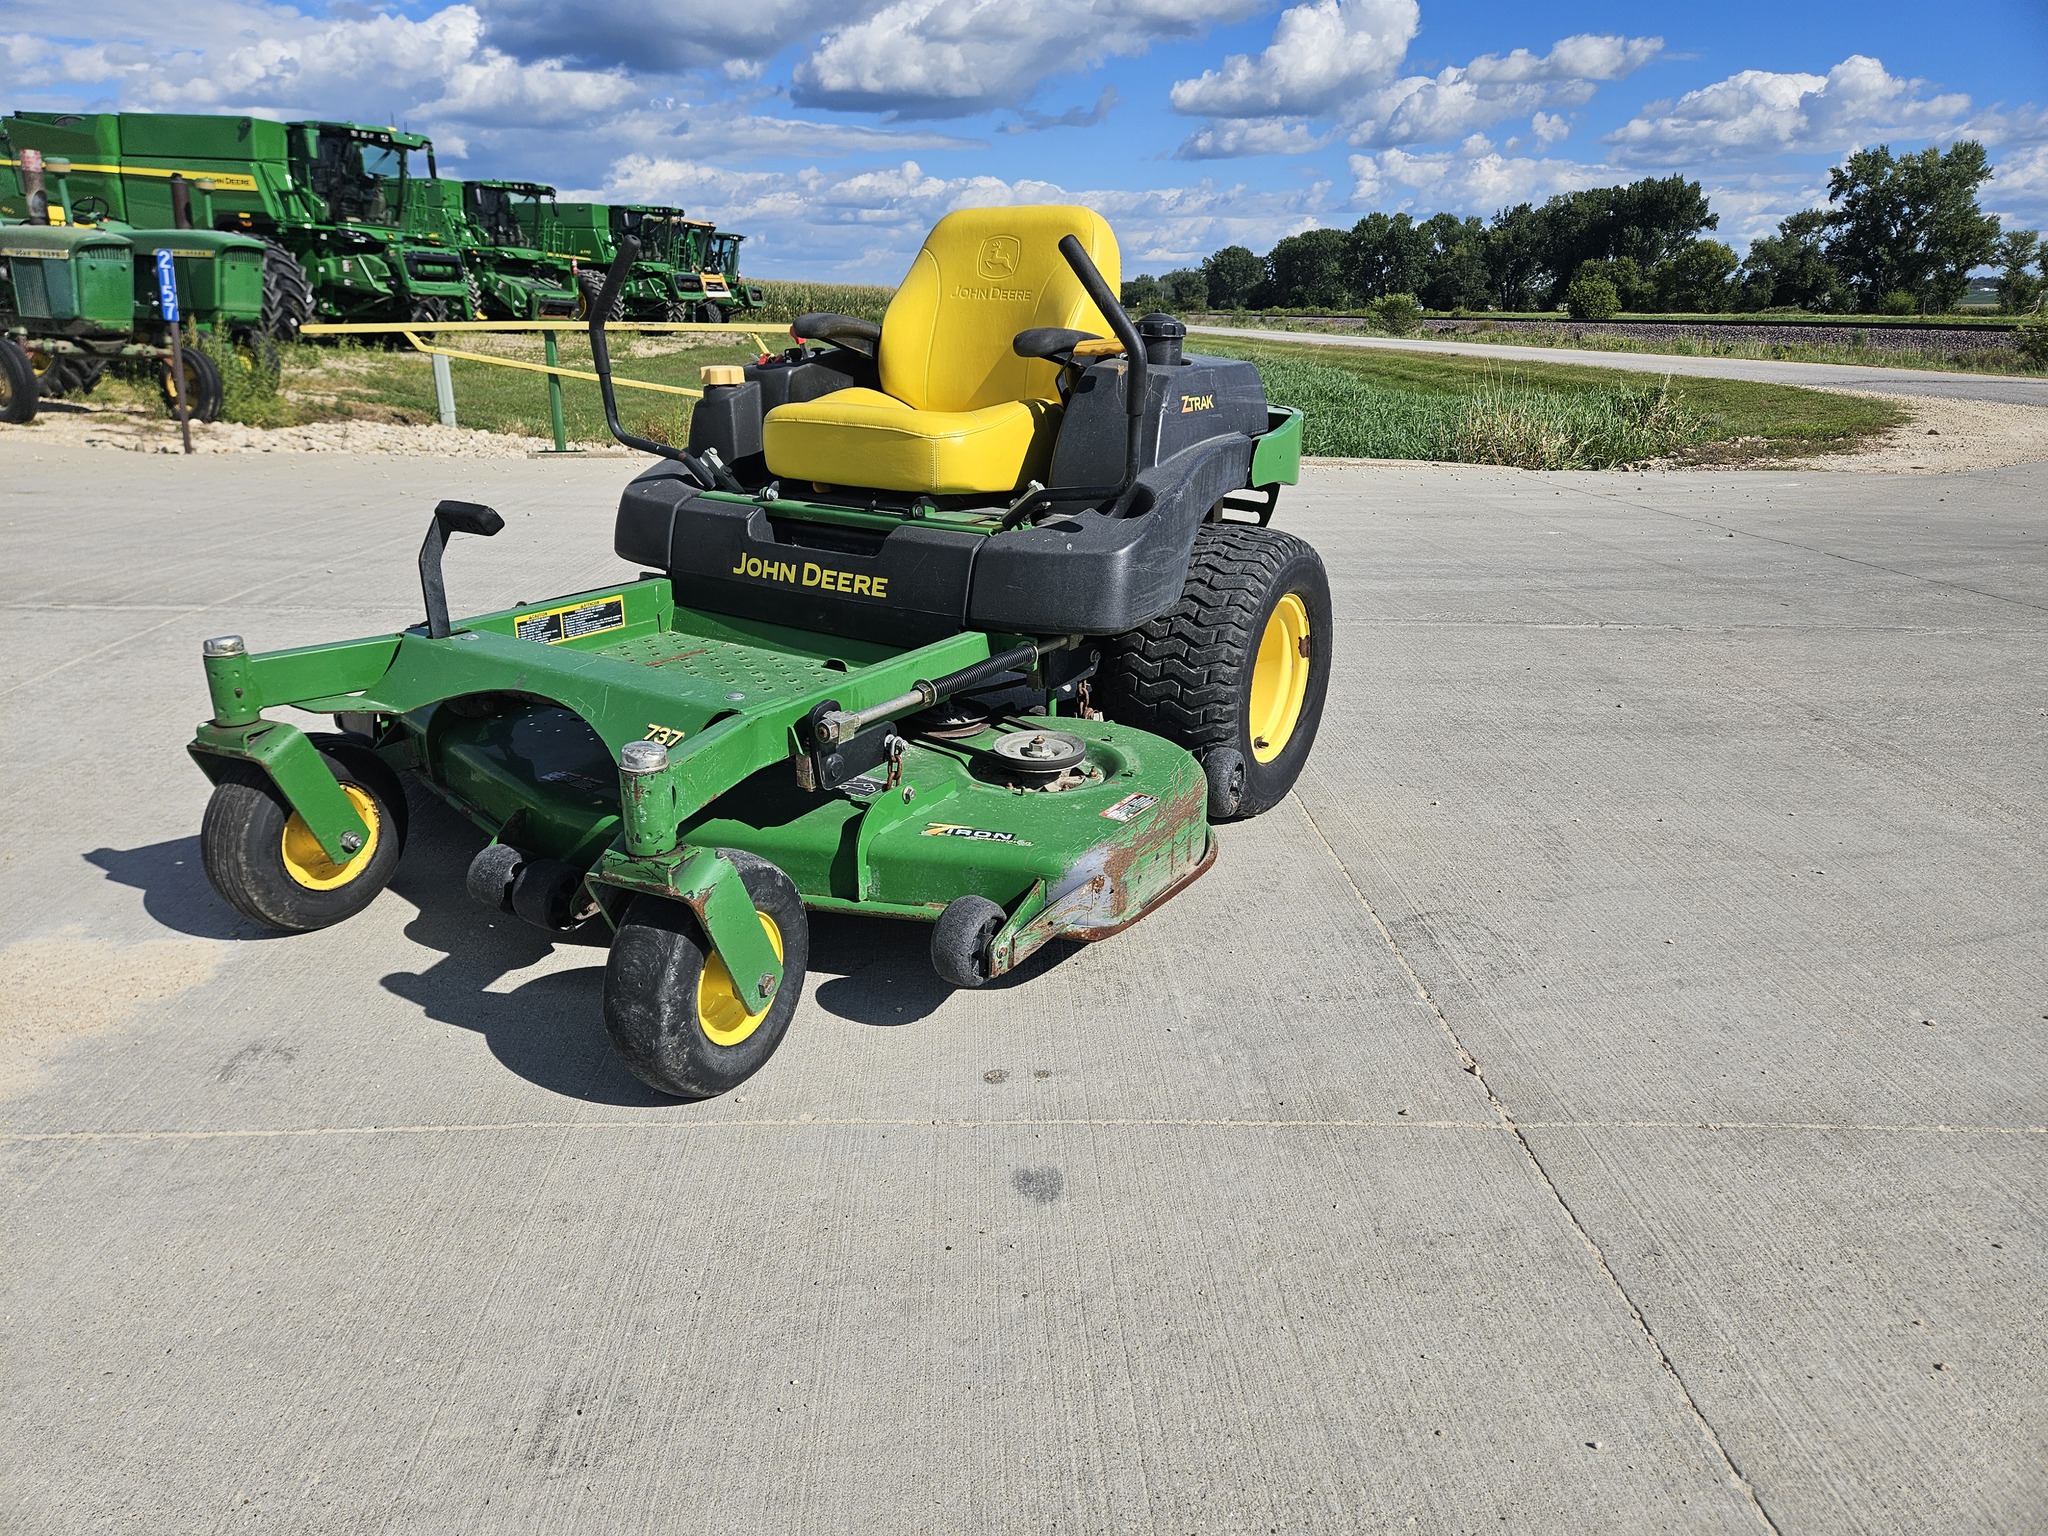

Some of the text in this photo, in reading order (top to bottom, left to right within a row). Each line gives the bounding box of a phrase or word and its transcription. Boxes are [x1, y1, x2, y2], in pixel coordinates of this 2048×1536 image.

[158, 250, 175, 321] 2157
[950, 285, 1032, 301] JOHN DEERE
[1181, 394, 1214, 413] ZTRAK
[733, 552, 888, 598] JOHN DEERE
[643, 723, 685, 748] 737
